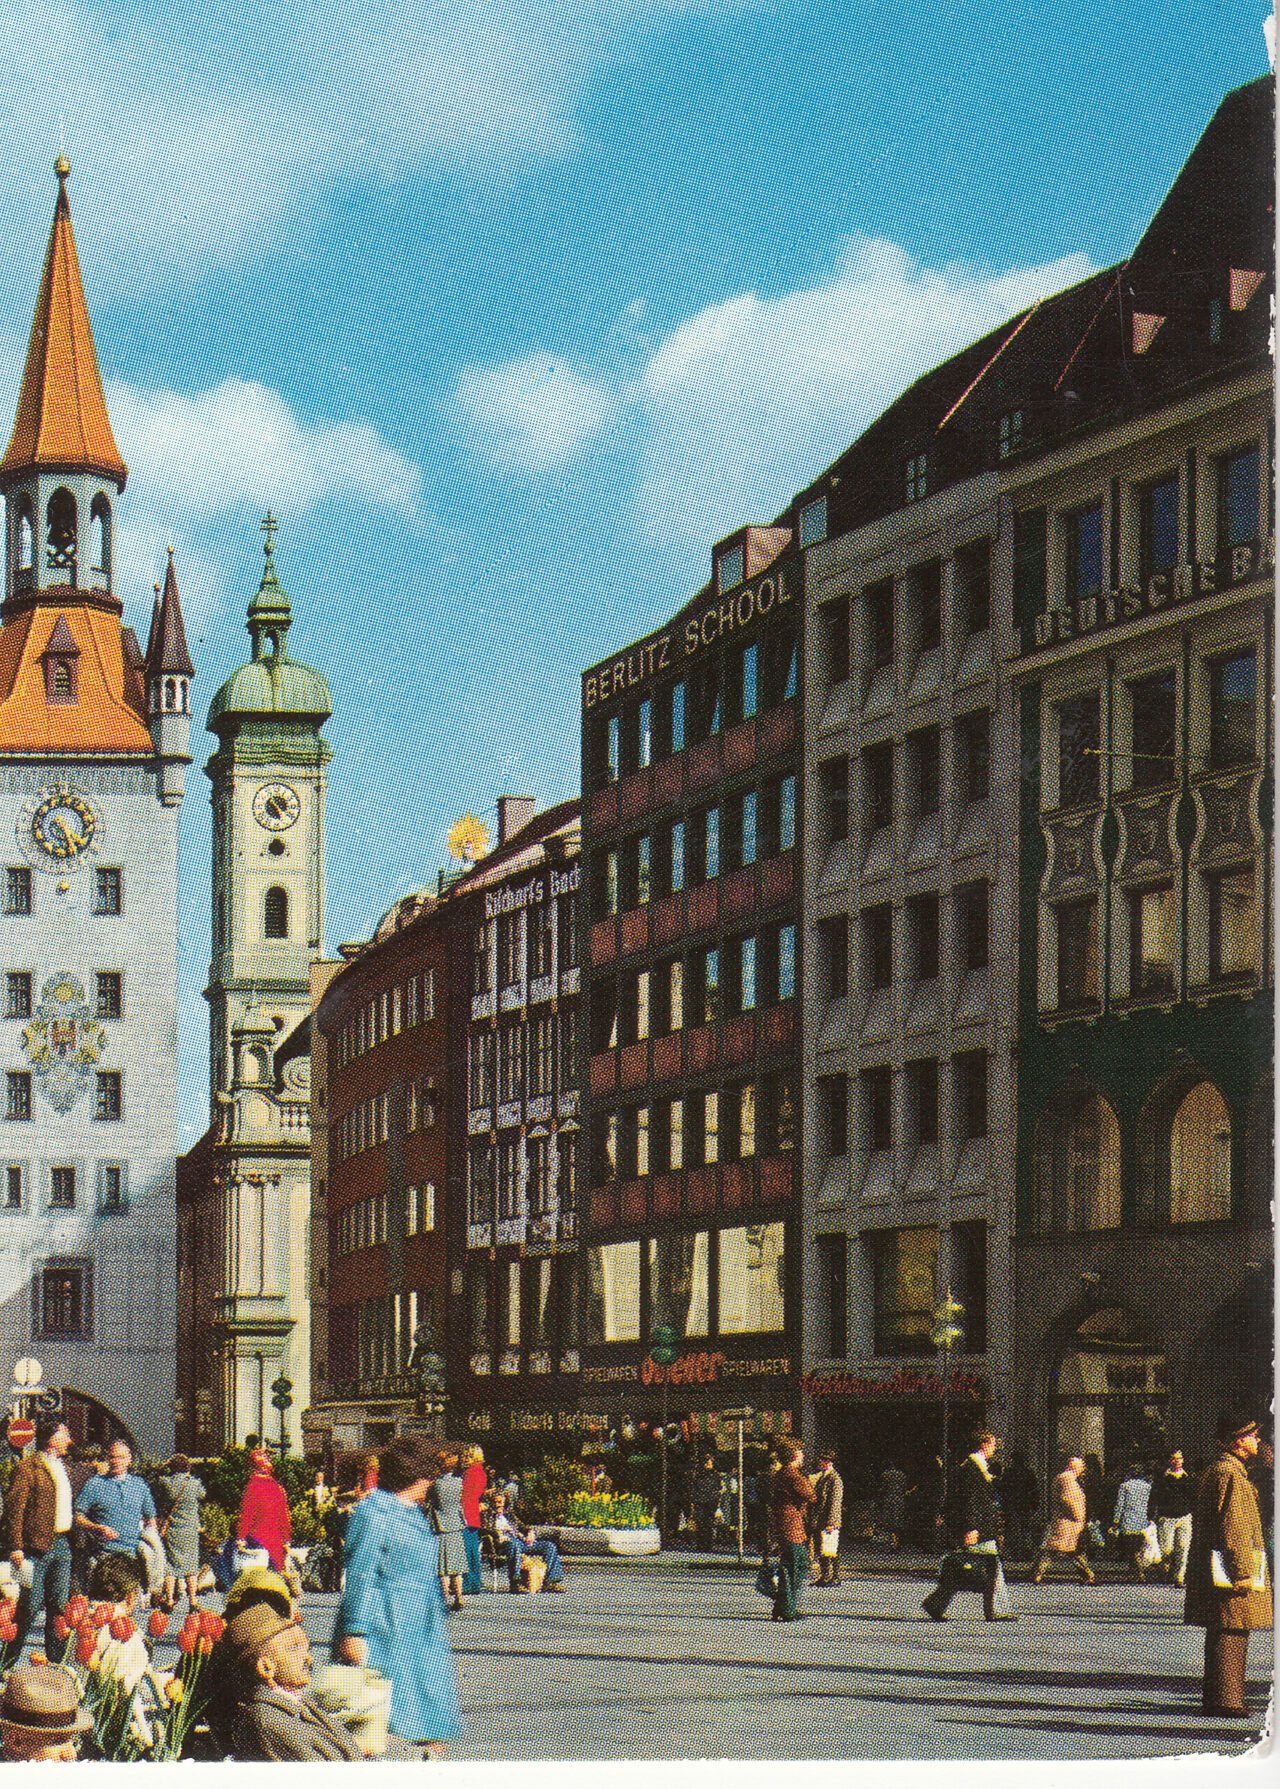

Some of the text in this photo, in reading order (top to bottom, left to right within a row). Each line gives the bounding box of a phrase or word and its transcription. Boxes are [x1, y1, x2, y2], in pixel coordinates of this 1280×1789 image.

[586, 571, 790, 708] BERLITZ SCHOOL
[1034, 559, 1216, 646] DEUTSCHE
